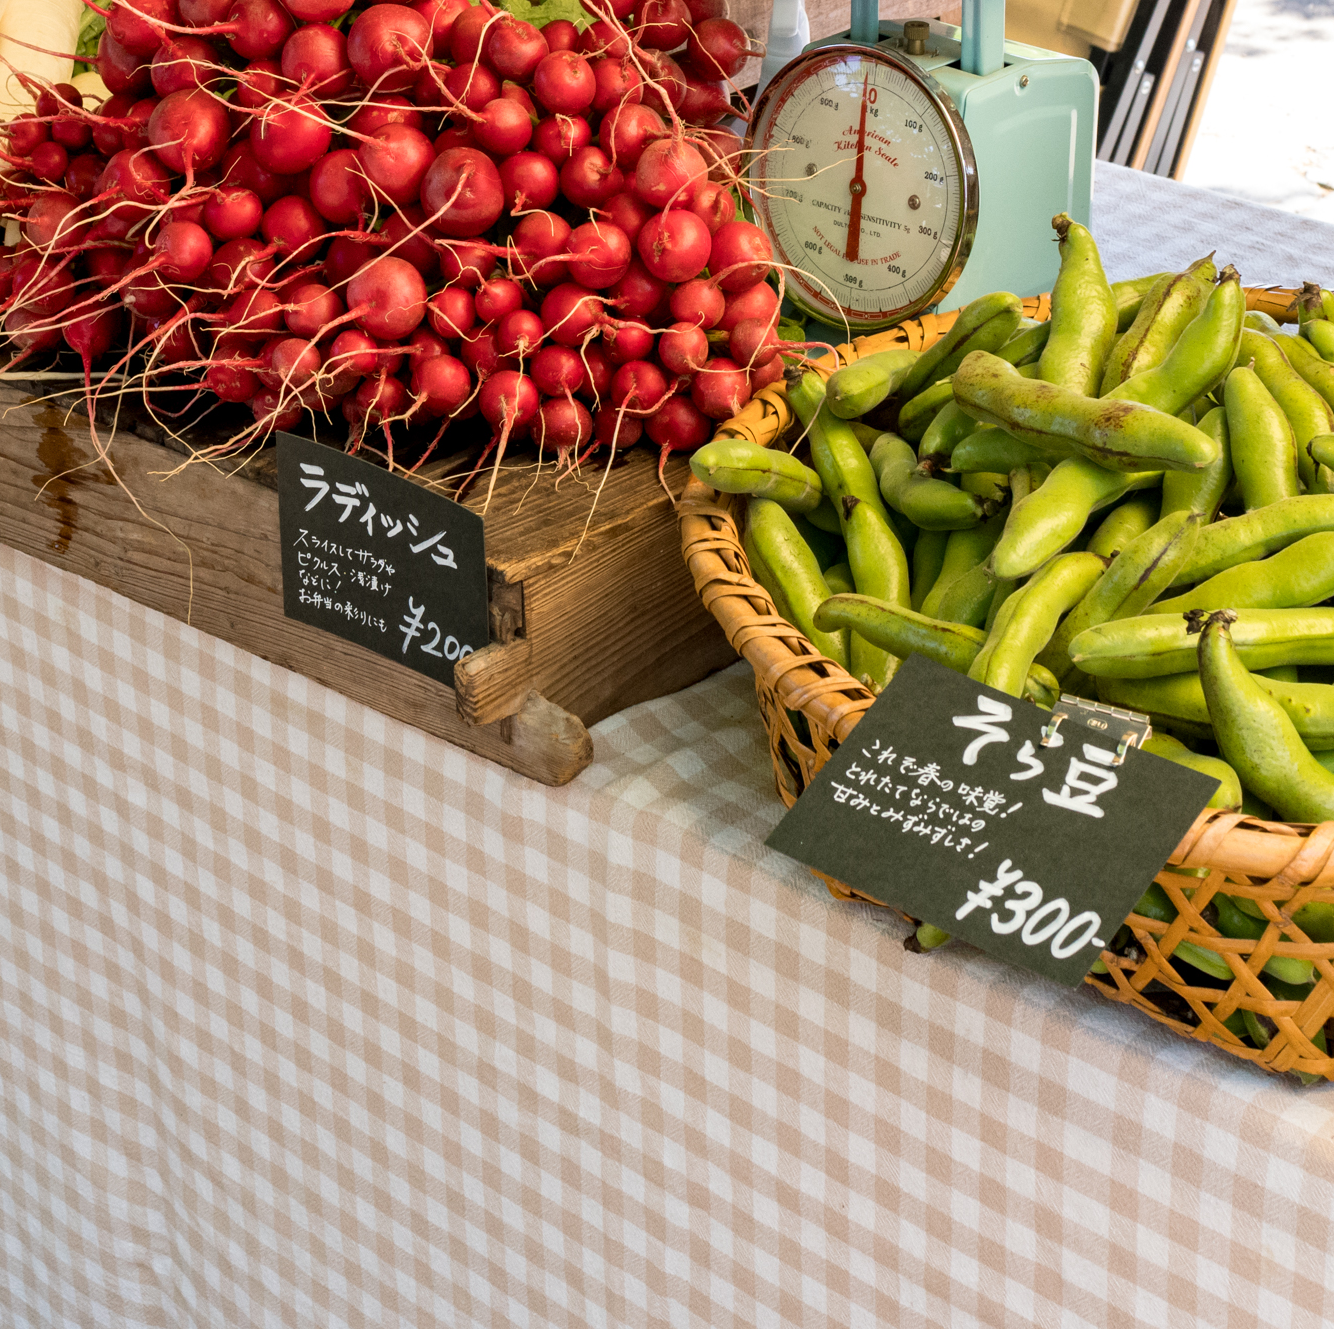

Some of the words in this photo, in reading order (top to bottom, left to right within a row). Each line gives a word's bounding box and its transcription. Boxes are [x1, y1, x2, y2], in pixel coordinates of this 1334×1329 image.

[833, 140, 872, 152] Kitchn
[874, 146, 900, 169] Scale
[842, 125, 892, 147] Amrican
[811, 199, 842, 214] CAPACITY
[860, 212, 903, 230] SENSITIVITY
[833, 219, 849, 229] DULT
[812, 225, 825, 241] NOT
[823, 239, 841, 257] LEGAL
[879, 250, 902, 265] TRADE
[299, 462, 458, 570] ラディッシュ
[293, 528, 396, 577] スライスしてサラダや
[299, 569, 342, 594] などに!
[298, 588, 388, 633] お弁当の彩りにも
[951, 694, 1120, 819] そら豆
[845, 761, 986, 833] とれたてならではの
[861, 738, 1024, 819] これぞ春の味覚!
